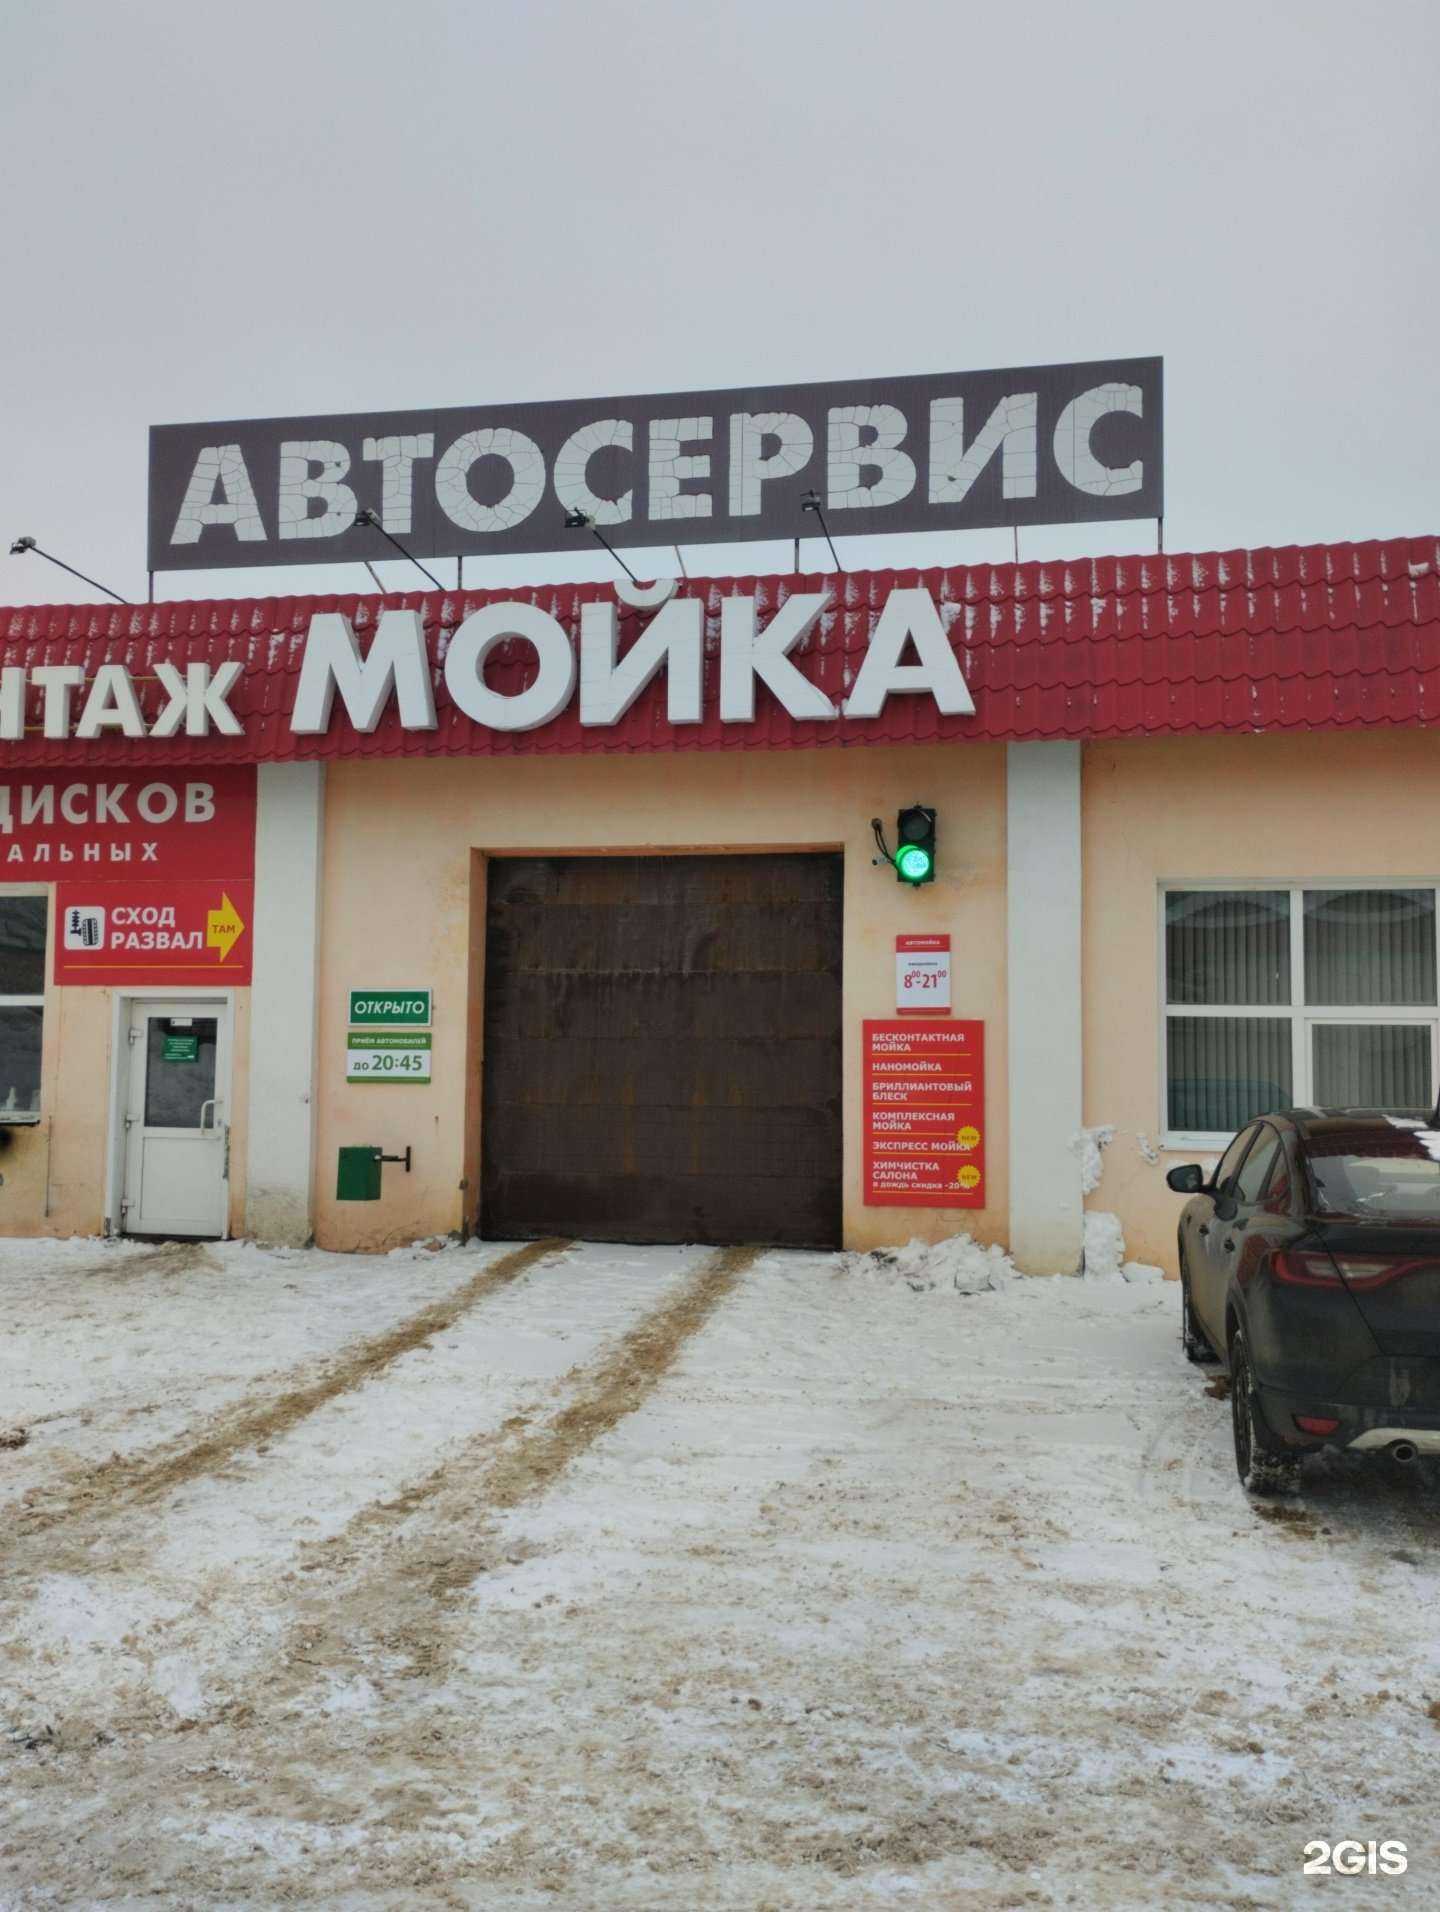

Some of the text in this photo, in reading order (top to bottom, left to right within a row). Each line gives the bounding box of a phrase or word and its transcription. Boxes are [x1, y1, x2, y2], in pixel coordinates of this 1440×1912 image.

[169, 382, 1144, 546] АВТОСЕРВИС
[290, 578, 977, 733] МОЙКА
[111, 906, 176, 928] СХОД
[212, 924, 236, 934] ТАМ
[111, 931, 204, 950] РАЗВАЛ
[354, 1000, 425, 1015] ОТКРЫТО
[872, 1033, 965, 1042] БЕСКОНТАКТНАЯ
[872, 1041, 912, 1052] МОЙКА
[353, 1054, 423, 1071] до 20:45
[872, 1061, 942, 1071] НАНОМОЙКА
[872, 1081, 972, 1091] БРИЛЛИАНТОВЫЙ
[872, 1091, 908, 1101] БЛЕСК
[872, 1112, 955, 1121] КОМПЛЕКСНАЯ
[872, 1121, 912, 1130] МОЙКА
[872, 1141, 928, 1150] ЭКСПРЕСС
[872, 1161, 940, 1171] ХИМЧИСТКА
[872, 1171, 918, 1180] САЛОНА
